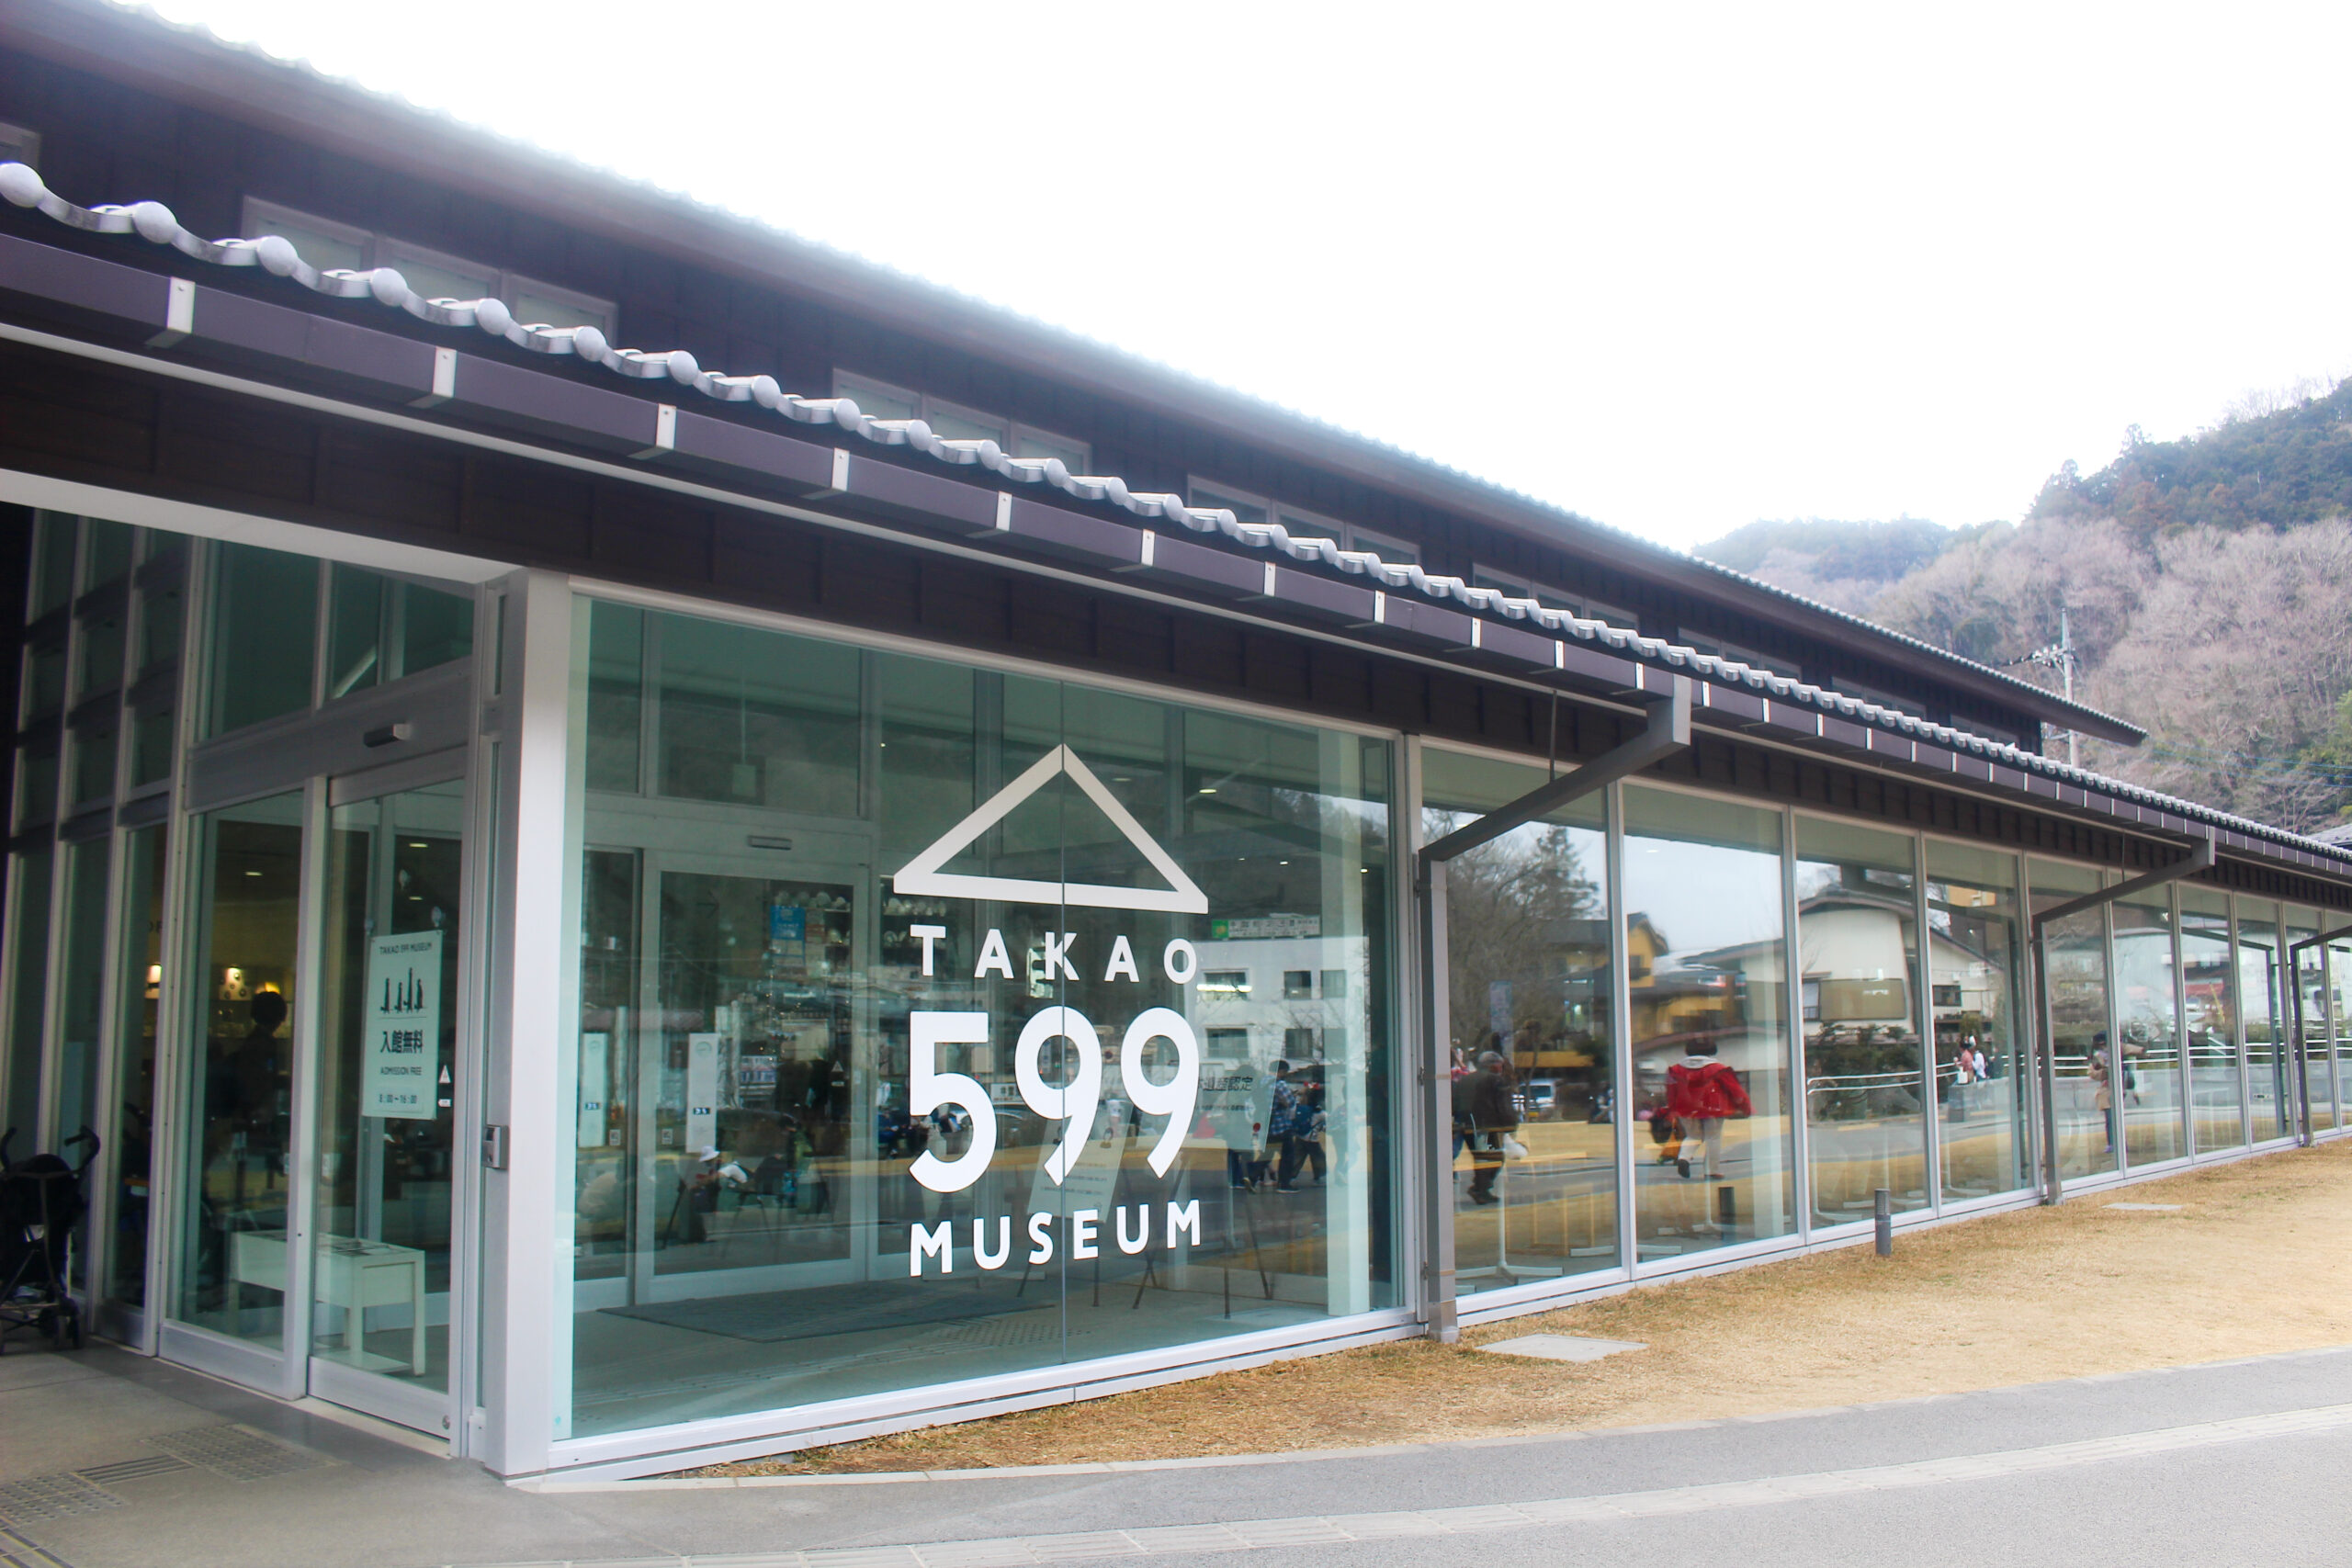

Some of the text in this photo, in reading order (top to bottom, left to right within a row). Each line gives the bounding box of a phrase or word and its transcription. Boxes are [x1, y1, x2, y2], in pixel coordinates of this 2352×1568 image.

[379, 944, 400, 955] TAKAO
[411, 942, 432, 953] MUSEUM
[910, 924, 1197, 985] TAKAO
[379, 1030, 424, 1054] 入館無料
[380, 1066, 423, 1076] ADMISSION FREE
[910, 1005, 1199, 1193] 599
[910, 1199, 1202, 1277] MUSEUM
